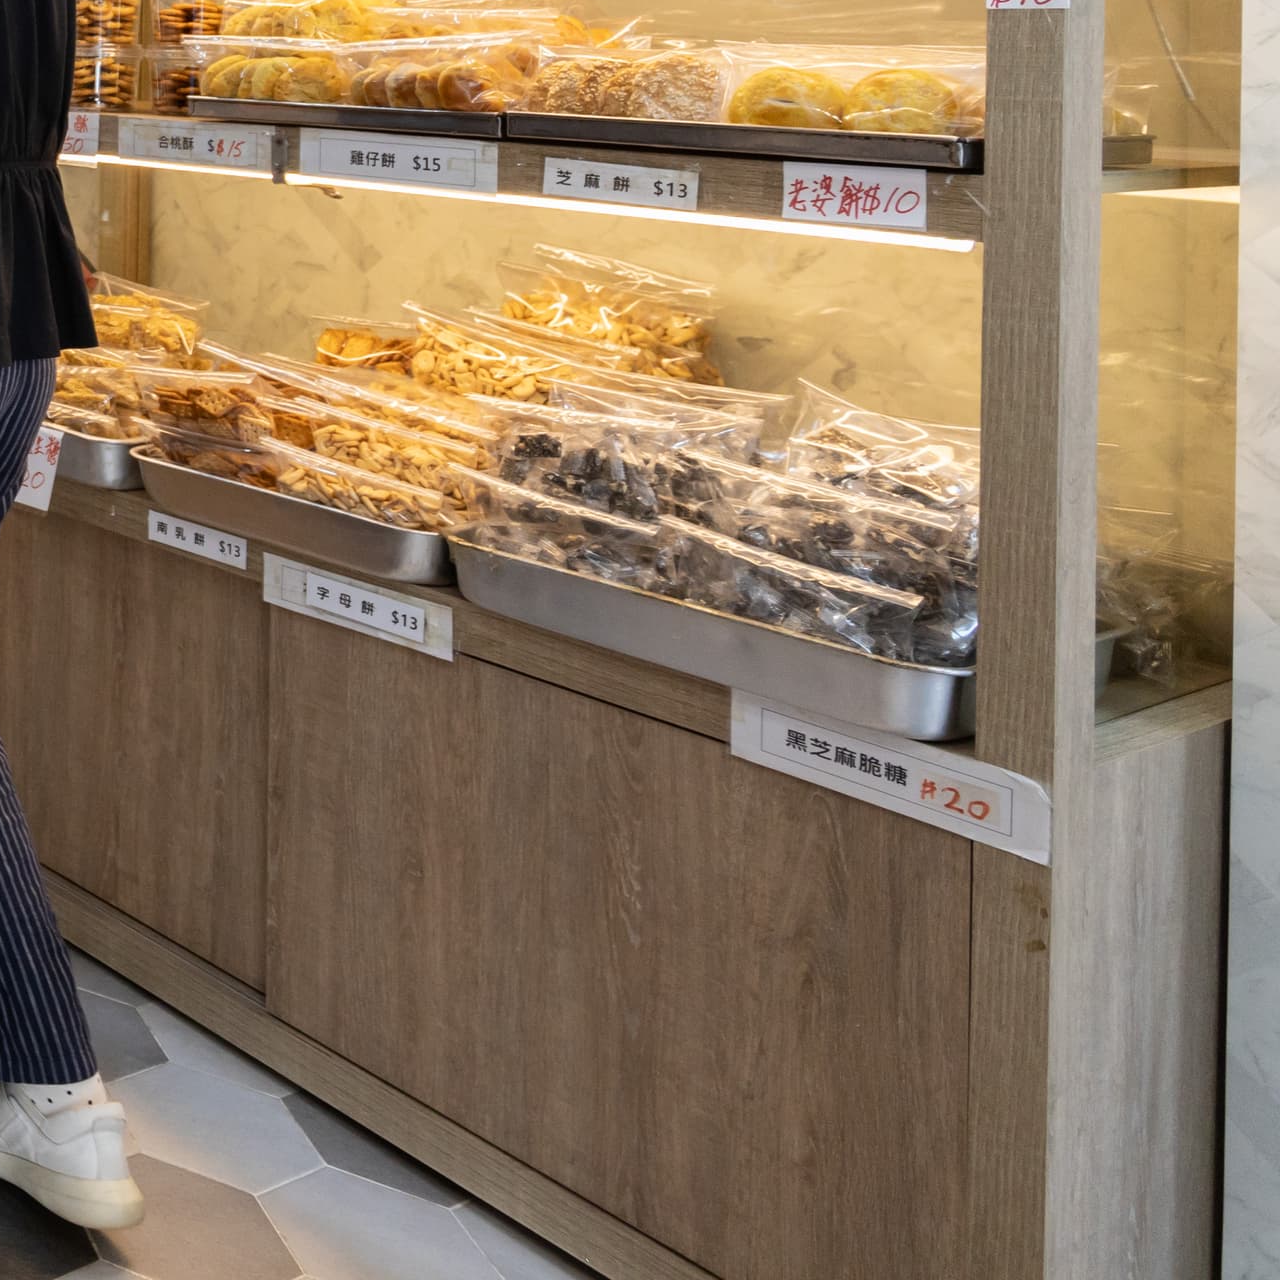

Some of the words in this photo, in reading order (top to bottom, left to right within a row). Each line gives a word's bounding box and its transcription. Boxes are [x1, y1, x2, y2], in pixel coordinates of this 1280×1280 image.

[158, 136, 195, 150] 合桃酥
[350, 150, 396, 170] 雞仔餅
[412, 156, 441, 173] $15
[653, 180, 688, 200] $13
[219, 540, 240, 558] $13
[392, 610, 418, 631] $13
[785, 728, 908, 786] 黑芝麻脆糖
